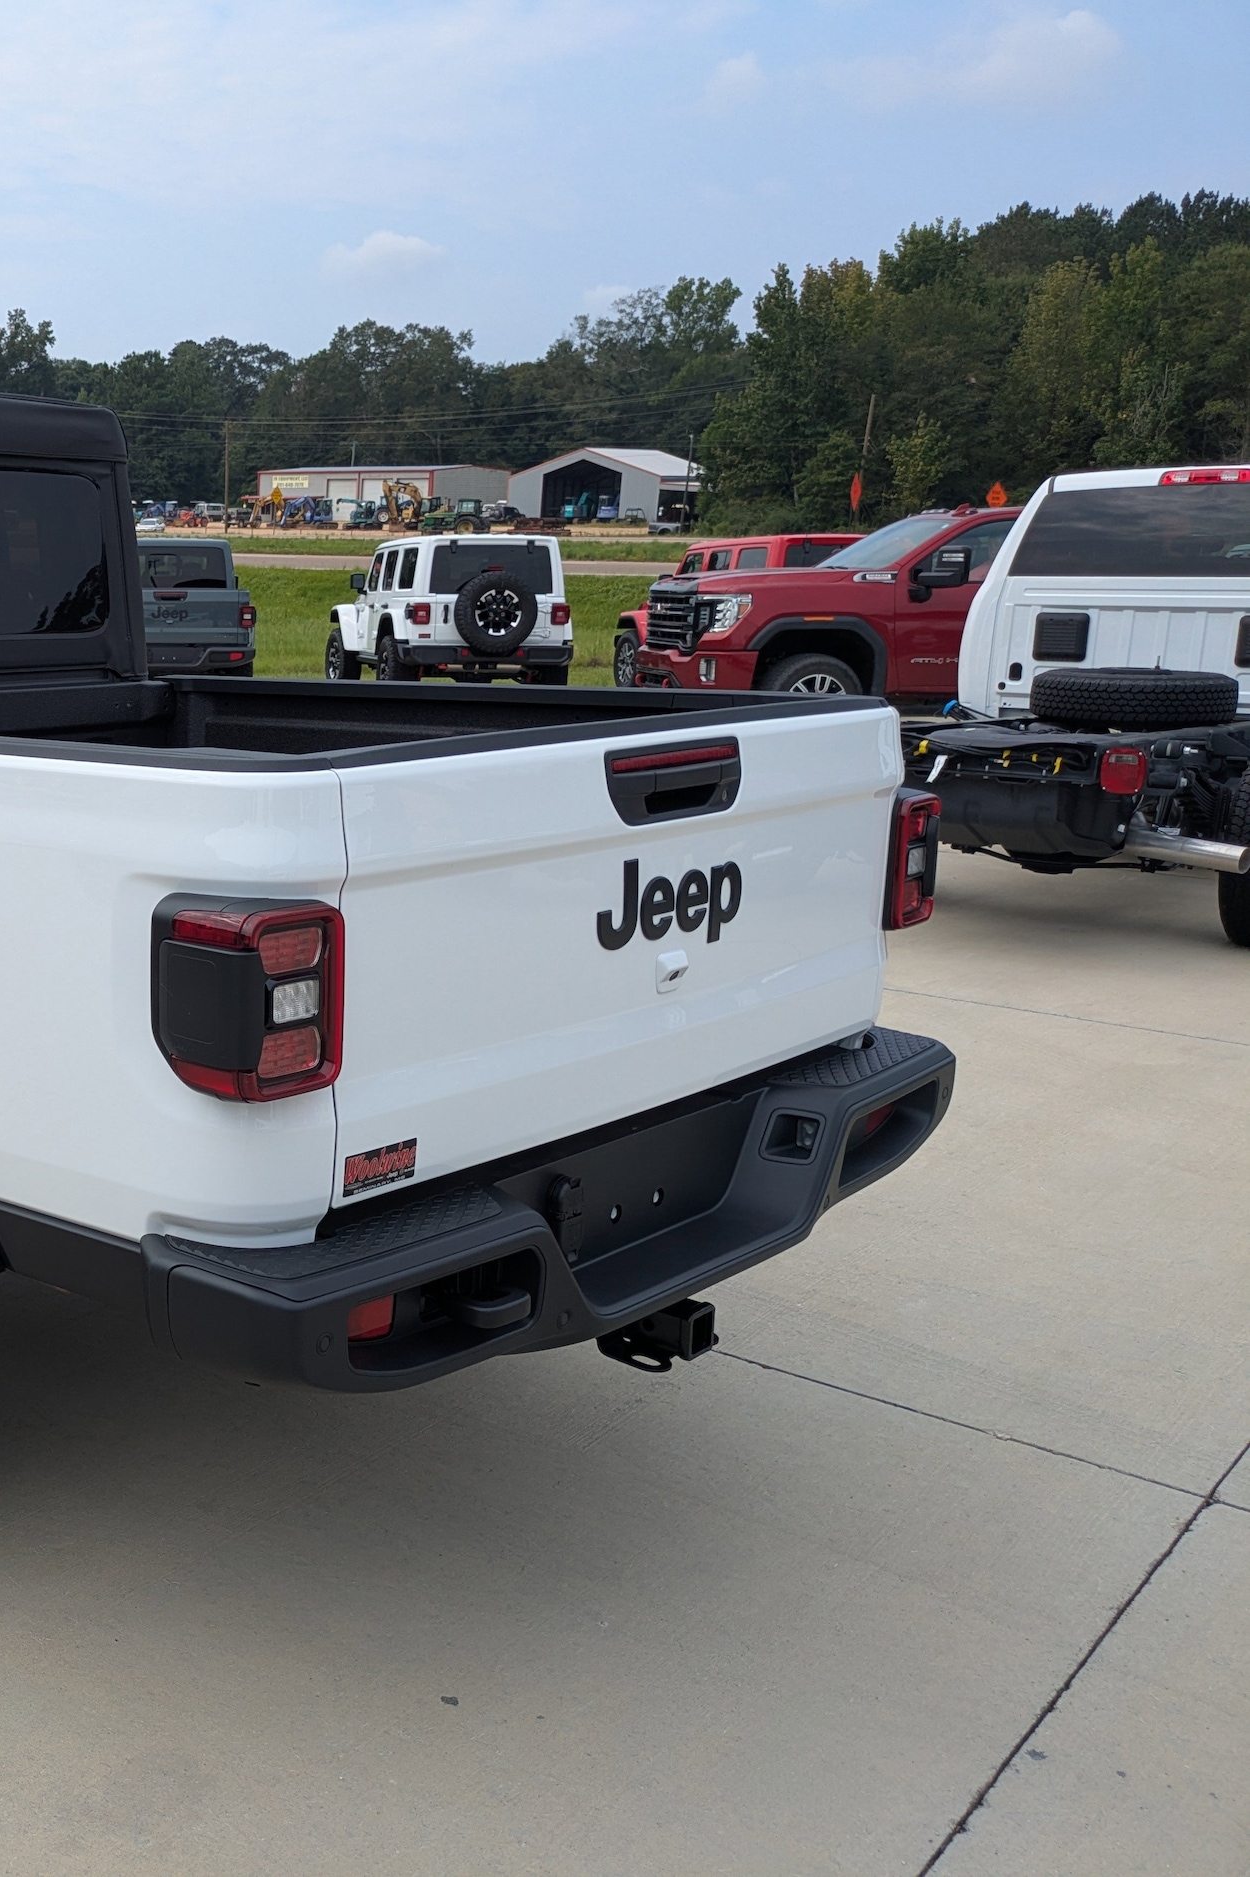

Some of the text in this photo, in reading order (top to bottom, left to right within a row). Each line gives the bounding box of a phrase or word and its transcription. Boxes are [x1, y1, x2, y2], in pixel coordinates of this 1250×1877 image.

[151, 606, 189, 621] Jeep
[597, 858, 742, 950] Jeep
[345, 1142, 416, 1185] Woolwine
